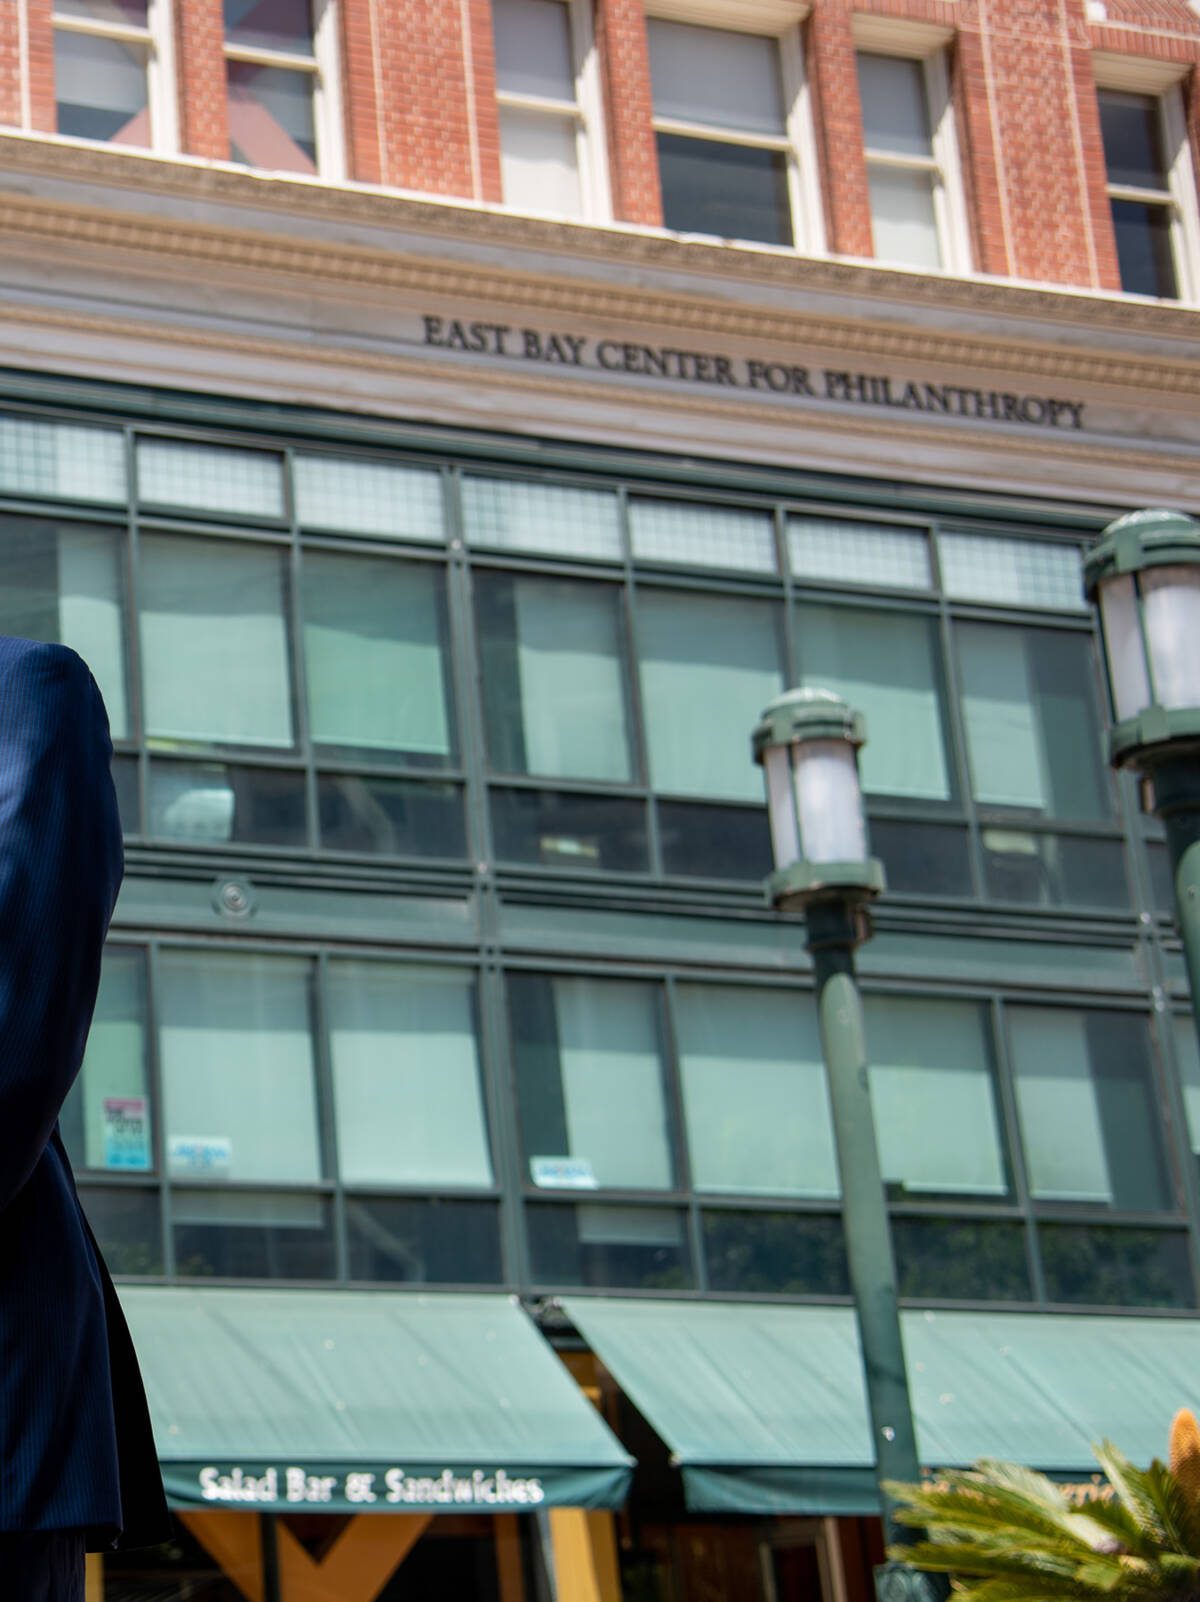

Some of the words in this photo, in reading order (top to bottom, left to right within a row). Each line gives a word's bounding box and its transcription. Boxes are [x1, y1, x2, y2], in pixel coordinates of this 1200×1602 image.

[422, 315, 511, 356] EAST
[519, 328, 587, 366] BAY
[594, 340, 738, 386] CENTER
[746, 359, 815, 396] FOR
[822, 368, 1085, 430] PHILANTHROPY
[199, 1466, 278, 1502] Salad
[285, 1466, 338, 1503] Bar
[384, 1467, 545, 1504] Sandwiches
